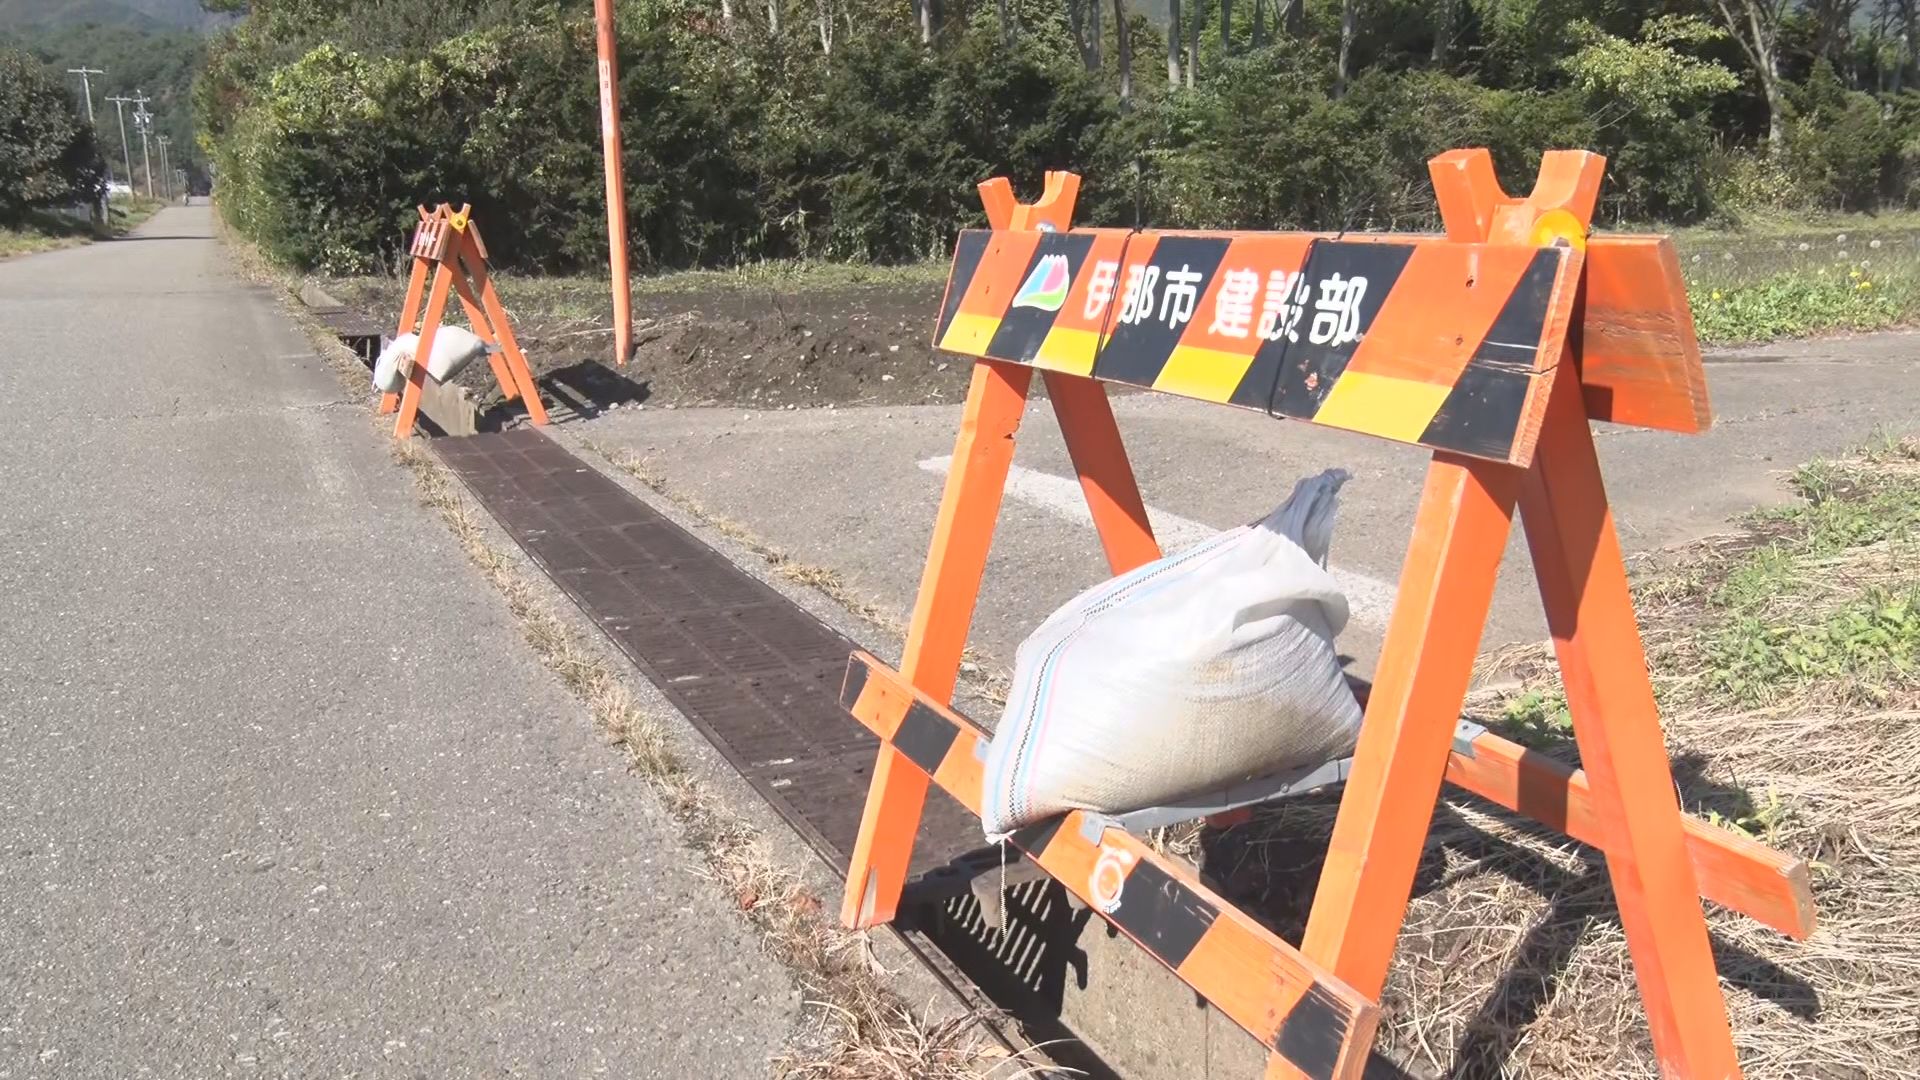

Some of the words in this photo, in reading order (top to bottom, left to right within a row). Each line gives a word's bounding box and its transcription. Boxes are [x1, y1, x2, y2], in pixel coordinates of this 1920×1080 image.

[1083, 260, 1368, 347] 伊那市建設部
